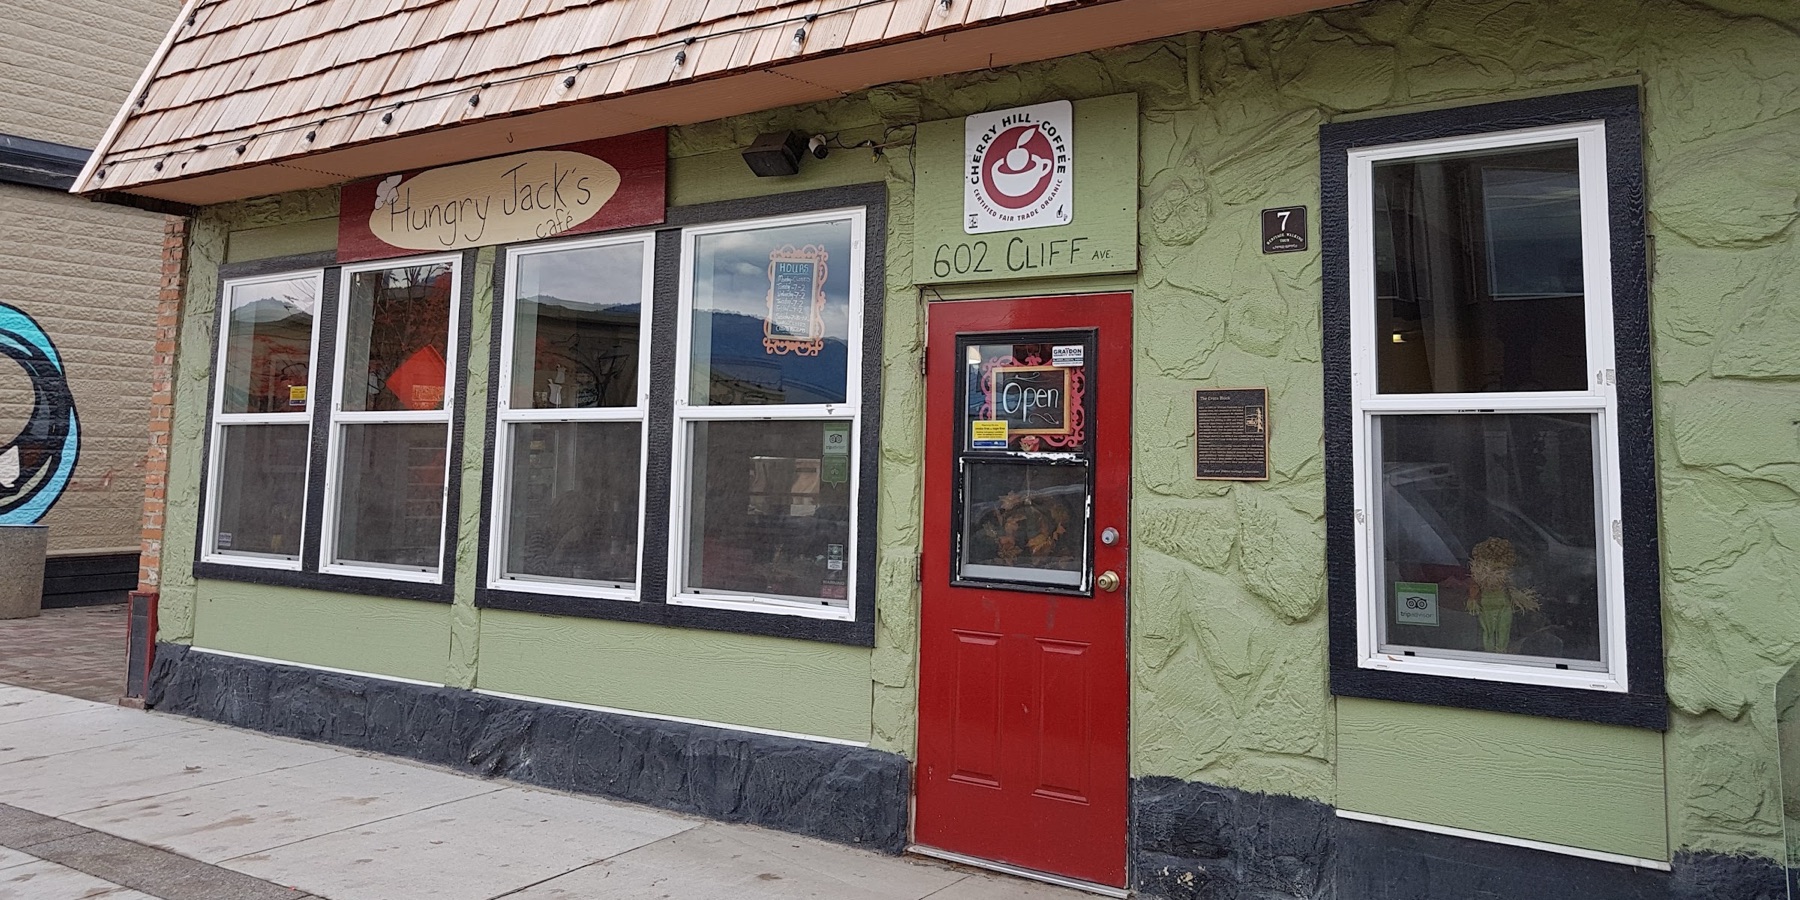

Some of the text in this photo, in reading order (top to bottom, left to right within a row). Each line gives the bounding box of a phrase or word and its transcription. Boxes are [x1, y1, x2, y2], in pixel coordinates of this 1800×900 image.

[971, 113, 1066, 185] CHERRY HILL COFFEE
[389, 162, 591, 246] Hungry Jack's
[973, 179, 1063, 222] CERTIFIED FAIR TRADE ORGANIC
[1277, 211, 1291, 231] 7
[535, 208, 574, 239] café
[933, 241, 993, 278] 602
[1006, 236, 1088, 272] CLIFF
[1002, 382, 1059, 423] Open
